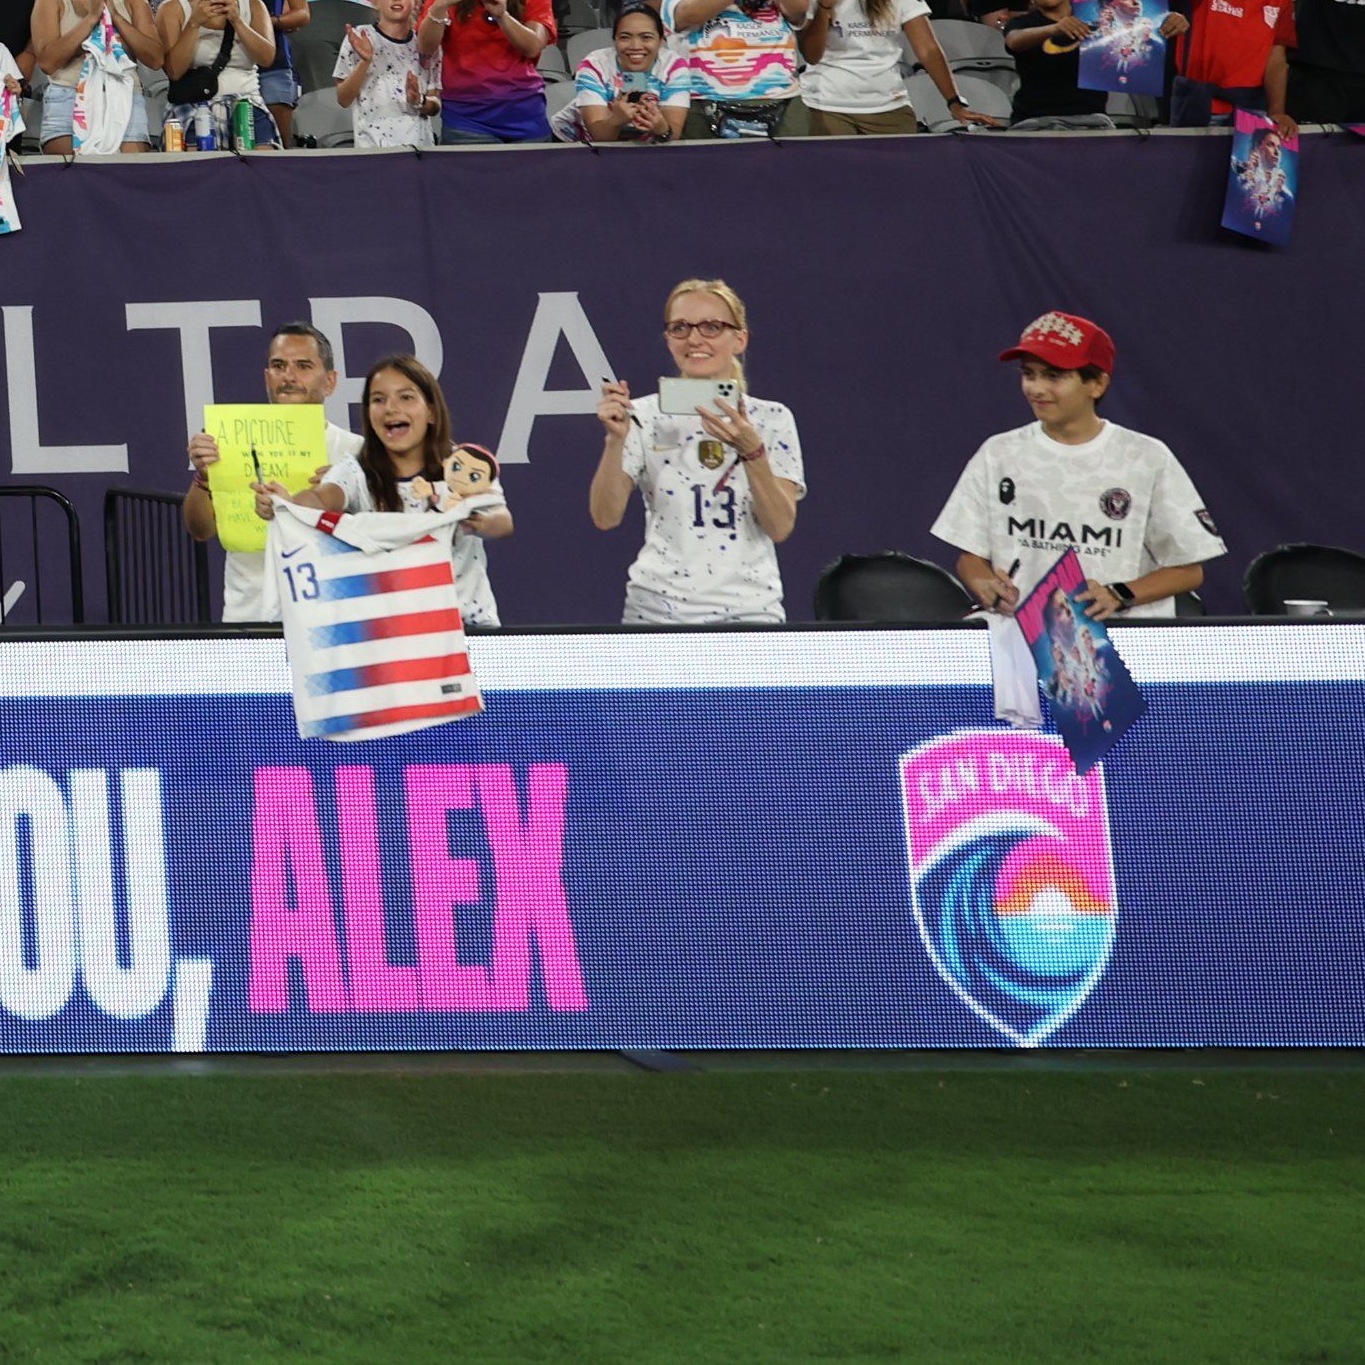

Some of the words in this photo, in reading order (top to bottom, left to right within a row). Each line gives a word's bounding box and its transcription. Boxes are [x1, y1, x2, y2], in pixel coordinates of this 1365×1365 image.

[217, 419, 228, 445] A
[233, 418, 296, 446] PICTURE
[244, 462, 290, 479] DEAM
[691, 483, 737, 530] 13
[1007, 516, 1123, 549] MIAMI
[281, 561, 321, 603] 13
[922, 757, 980, 822] SAN
[989, 752, 1093, 819] DIEGO
[248, 762, 592, 1014] ALEX
